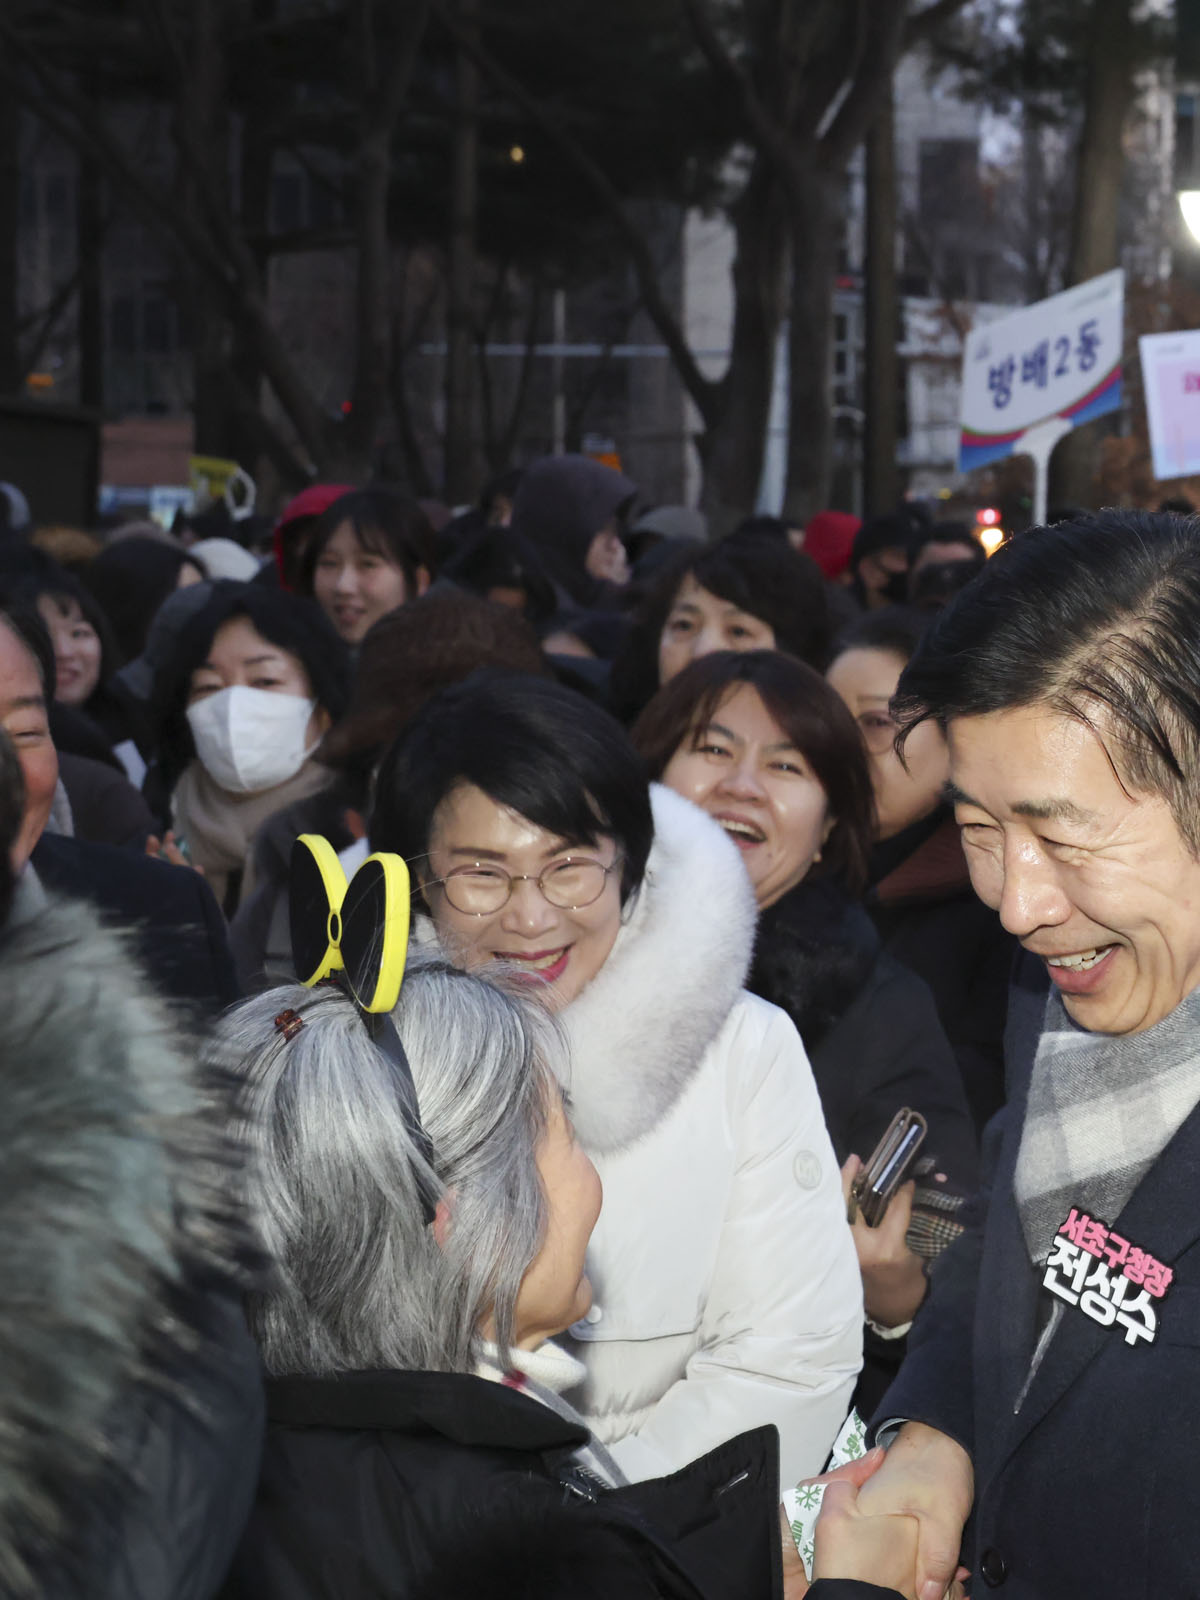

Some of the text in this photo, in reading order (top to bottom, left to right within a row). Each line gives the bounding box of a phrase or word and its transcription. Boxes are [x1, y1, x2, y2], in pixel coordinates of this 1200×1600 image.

[988, 318, 1101, 410] 방배2동
[1043, 1235, 1157, 1346] 전성수
[1058, 1208, 1173, 1298] 서초구청장
